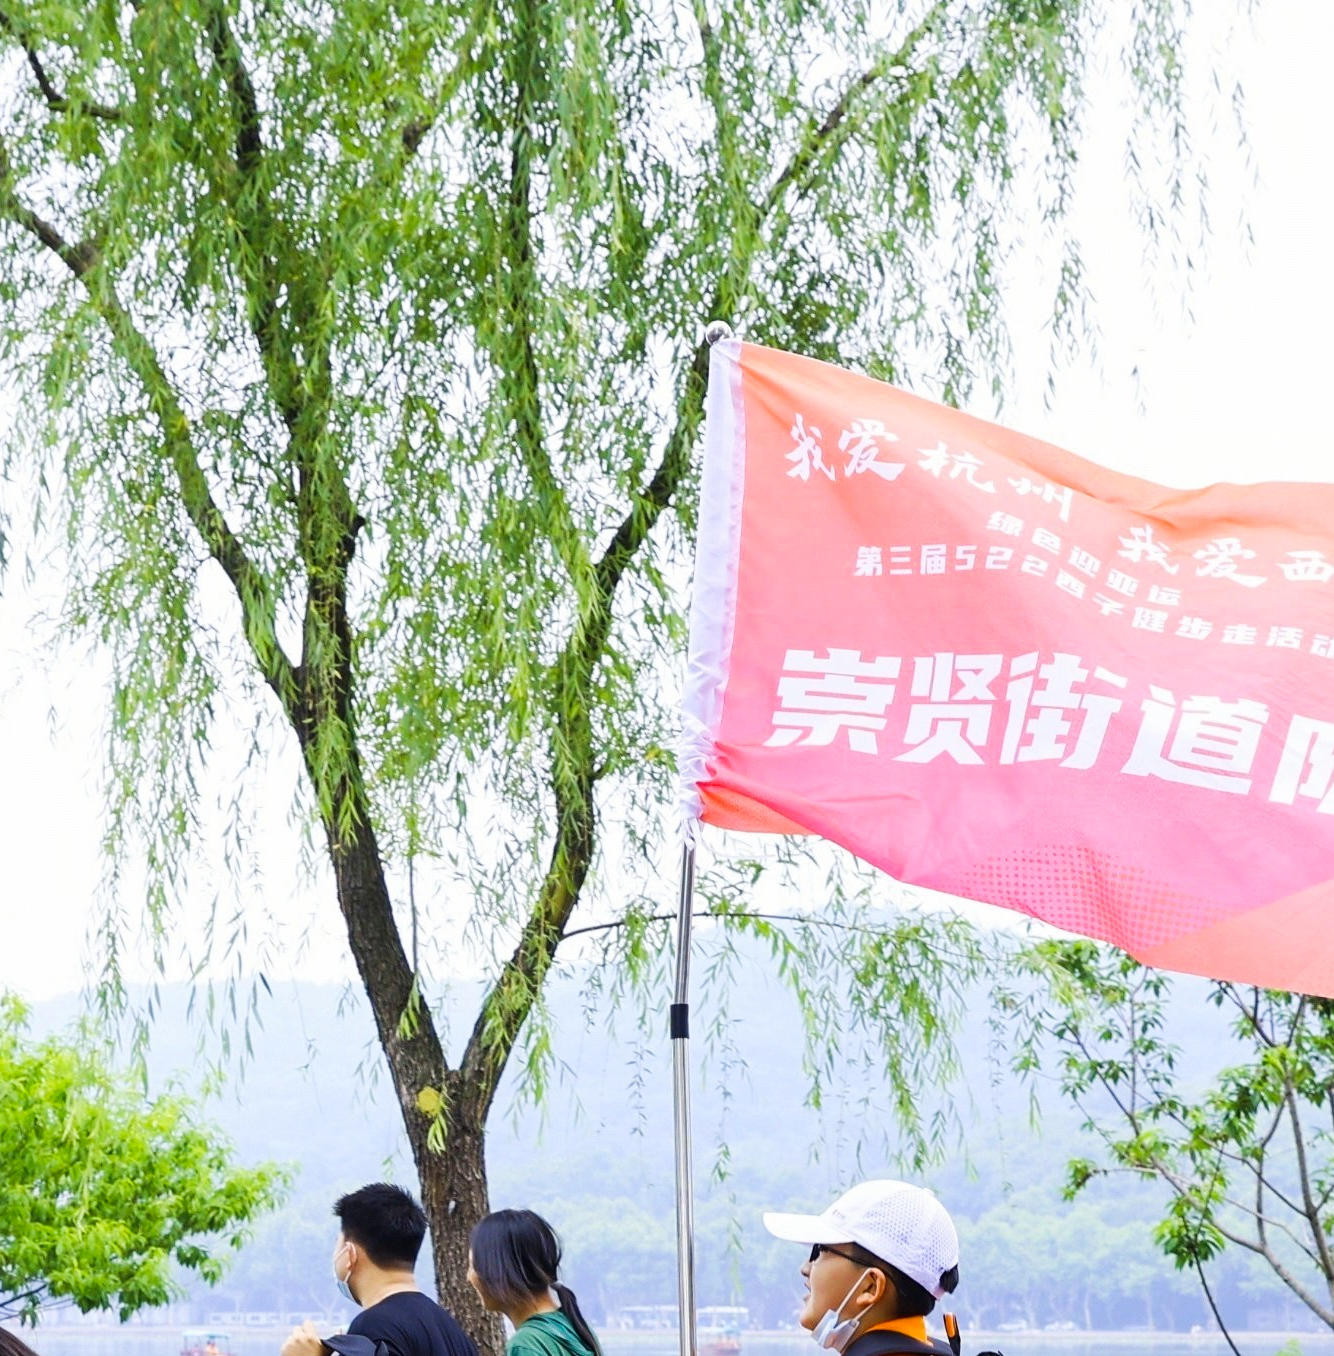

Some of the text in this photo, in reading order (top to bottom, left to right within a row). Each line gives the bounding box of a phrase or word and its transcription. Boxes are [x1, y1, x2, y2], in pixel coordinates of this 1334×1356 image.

[784, 412, 1074, 523] 我爱杭州
[986, 510, 1183, 607] 绿色迎亚运
